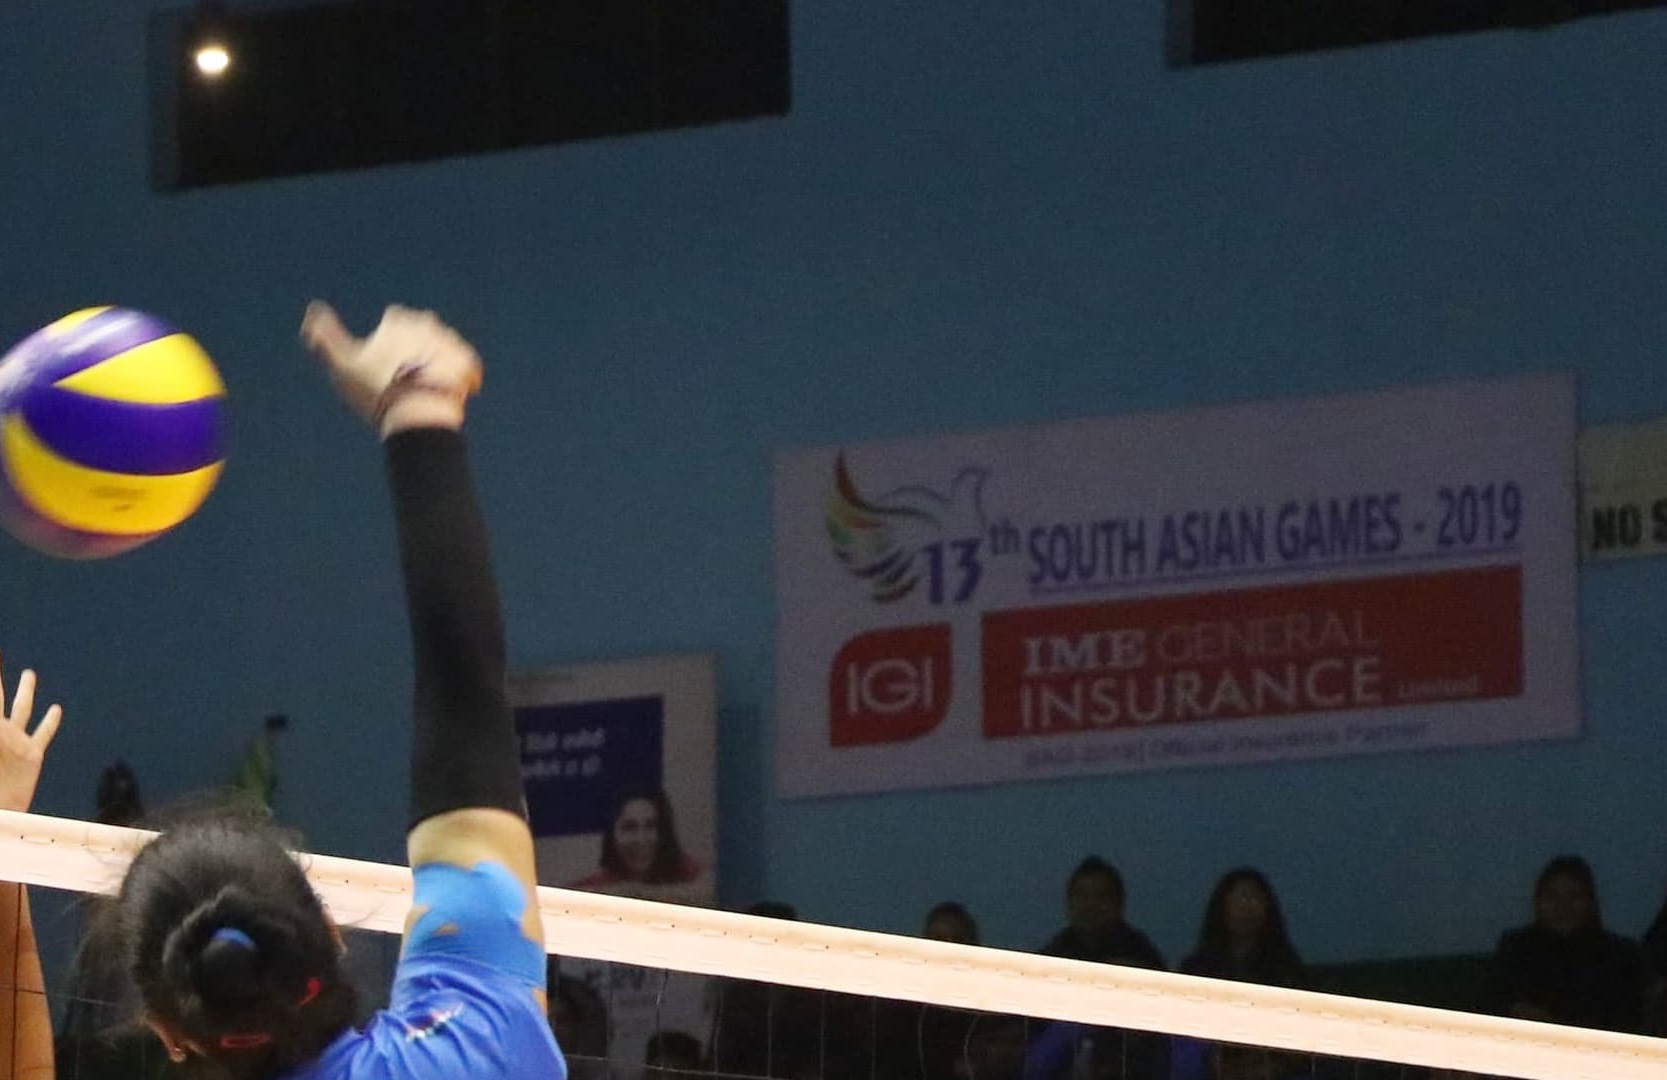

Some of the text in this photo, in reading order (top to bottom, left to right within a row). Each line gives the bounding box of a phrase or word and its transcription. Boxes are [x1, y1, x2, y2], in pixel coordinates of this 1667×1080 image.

[1029, 516, 1147, 586] SOUTH
[1155, 504, 1265, 572] ASIAN
[1275, 492, 1404, 562] GAMES
[1435, 480, 1523, 548] 2019
[1592, 503, 1643, 549] NO
[1023, 609, 1379, 674] IME GENERAL
[846, 656, 934, 715] IGI
[1020, 653, 1384, 731] INSURANCE
